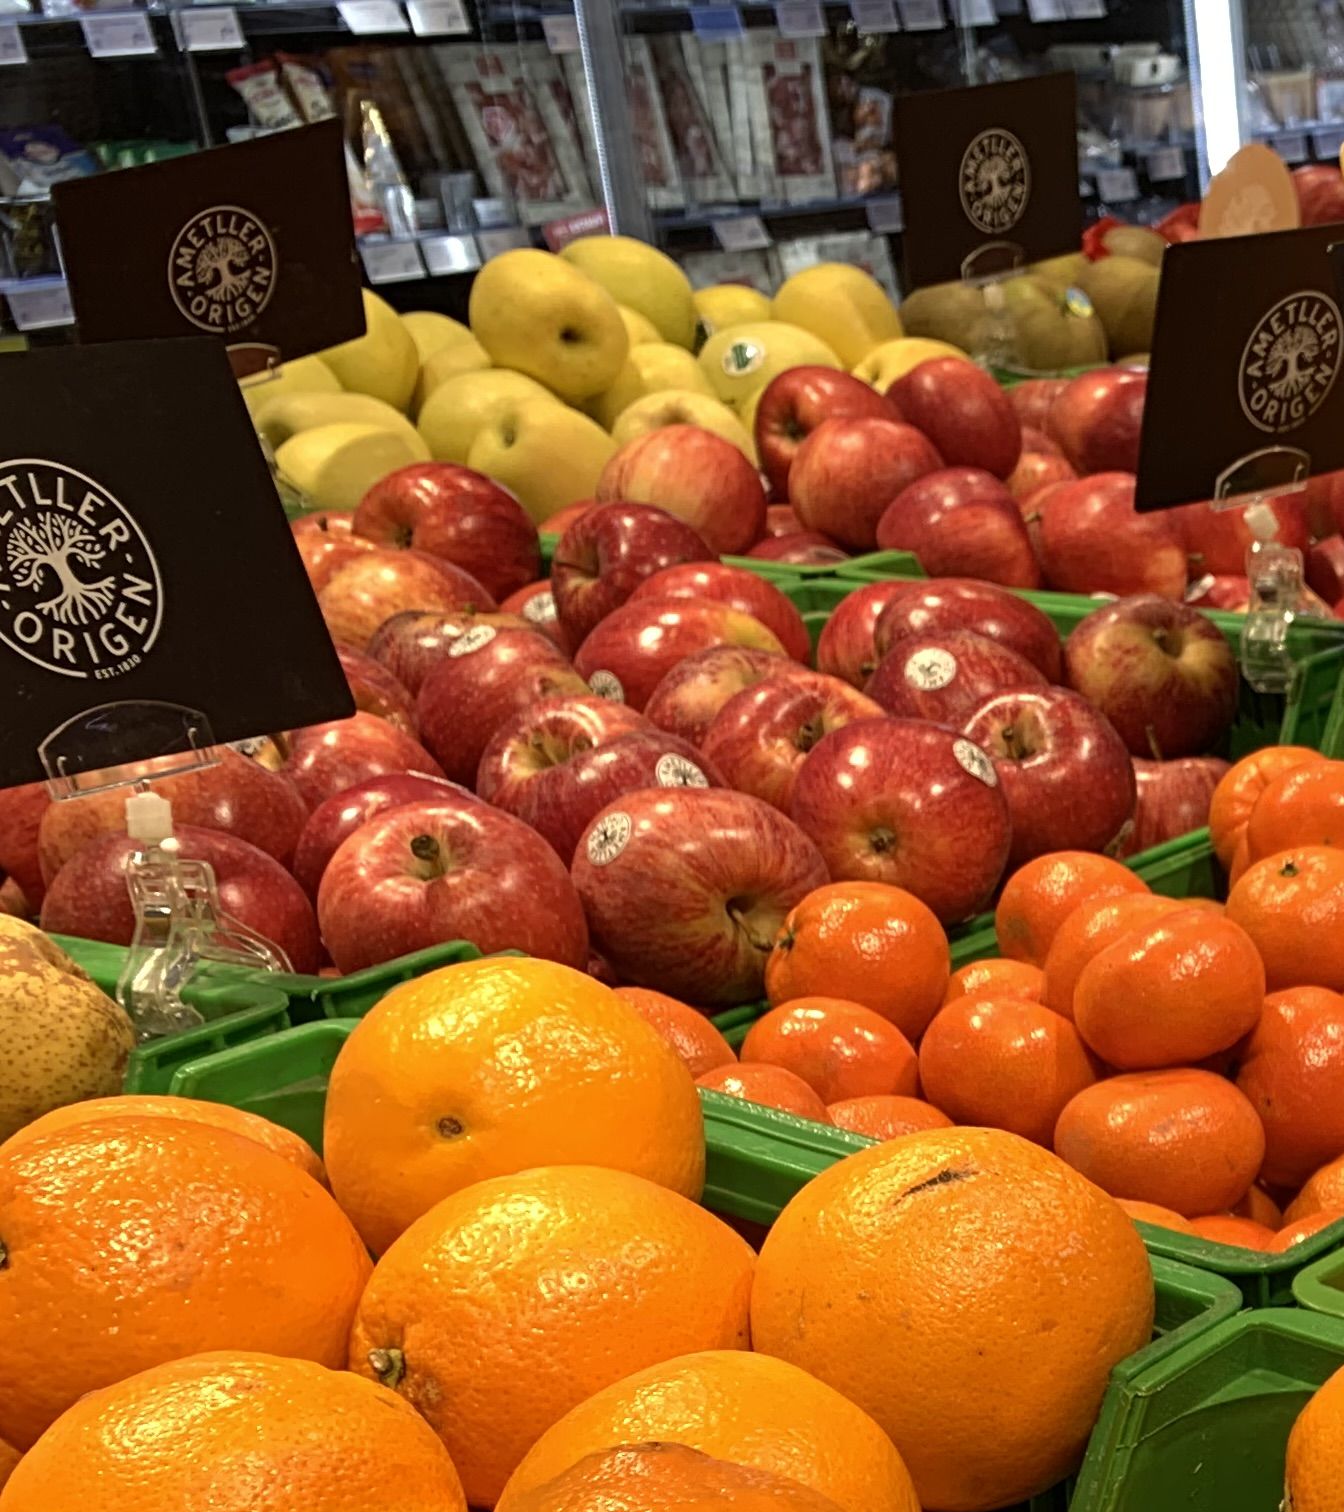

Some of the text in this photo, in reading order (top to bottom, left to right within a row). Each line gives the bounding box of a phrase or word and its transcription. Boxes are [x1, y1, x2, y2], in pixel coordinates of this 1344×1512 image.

[176, 214, 266, 287] AMETLLER
[190, 266, 271, 325] ORIGEN
[1246, 300, 1338, 378] AMETLLER
[1250, 363, 1334, 423] ORIGEN
[13, 573, 153, 664] ORIGEN
